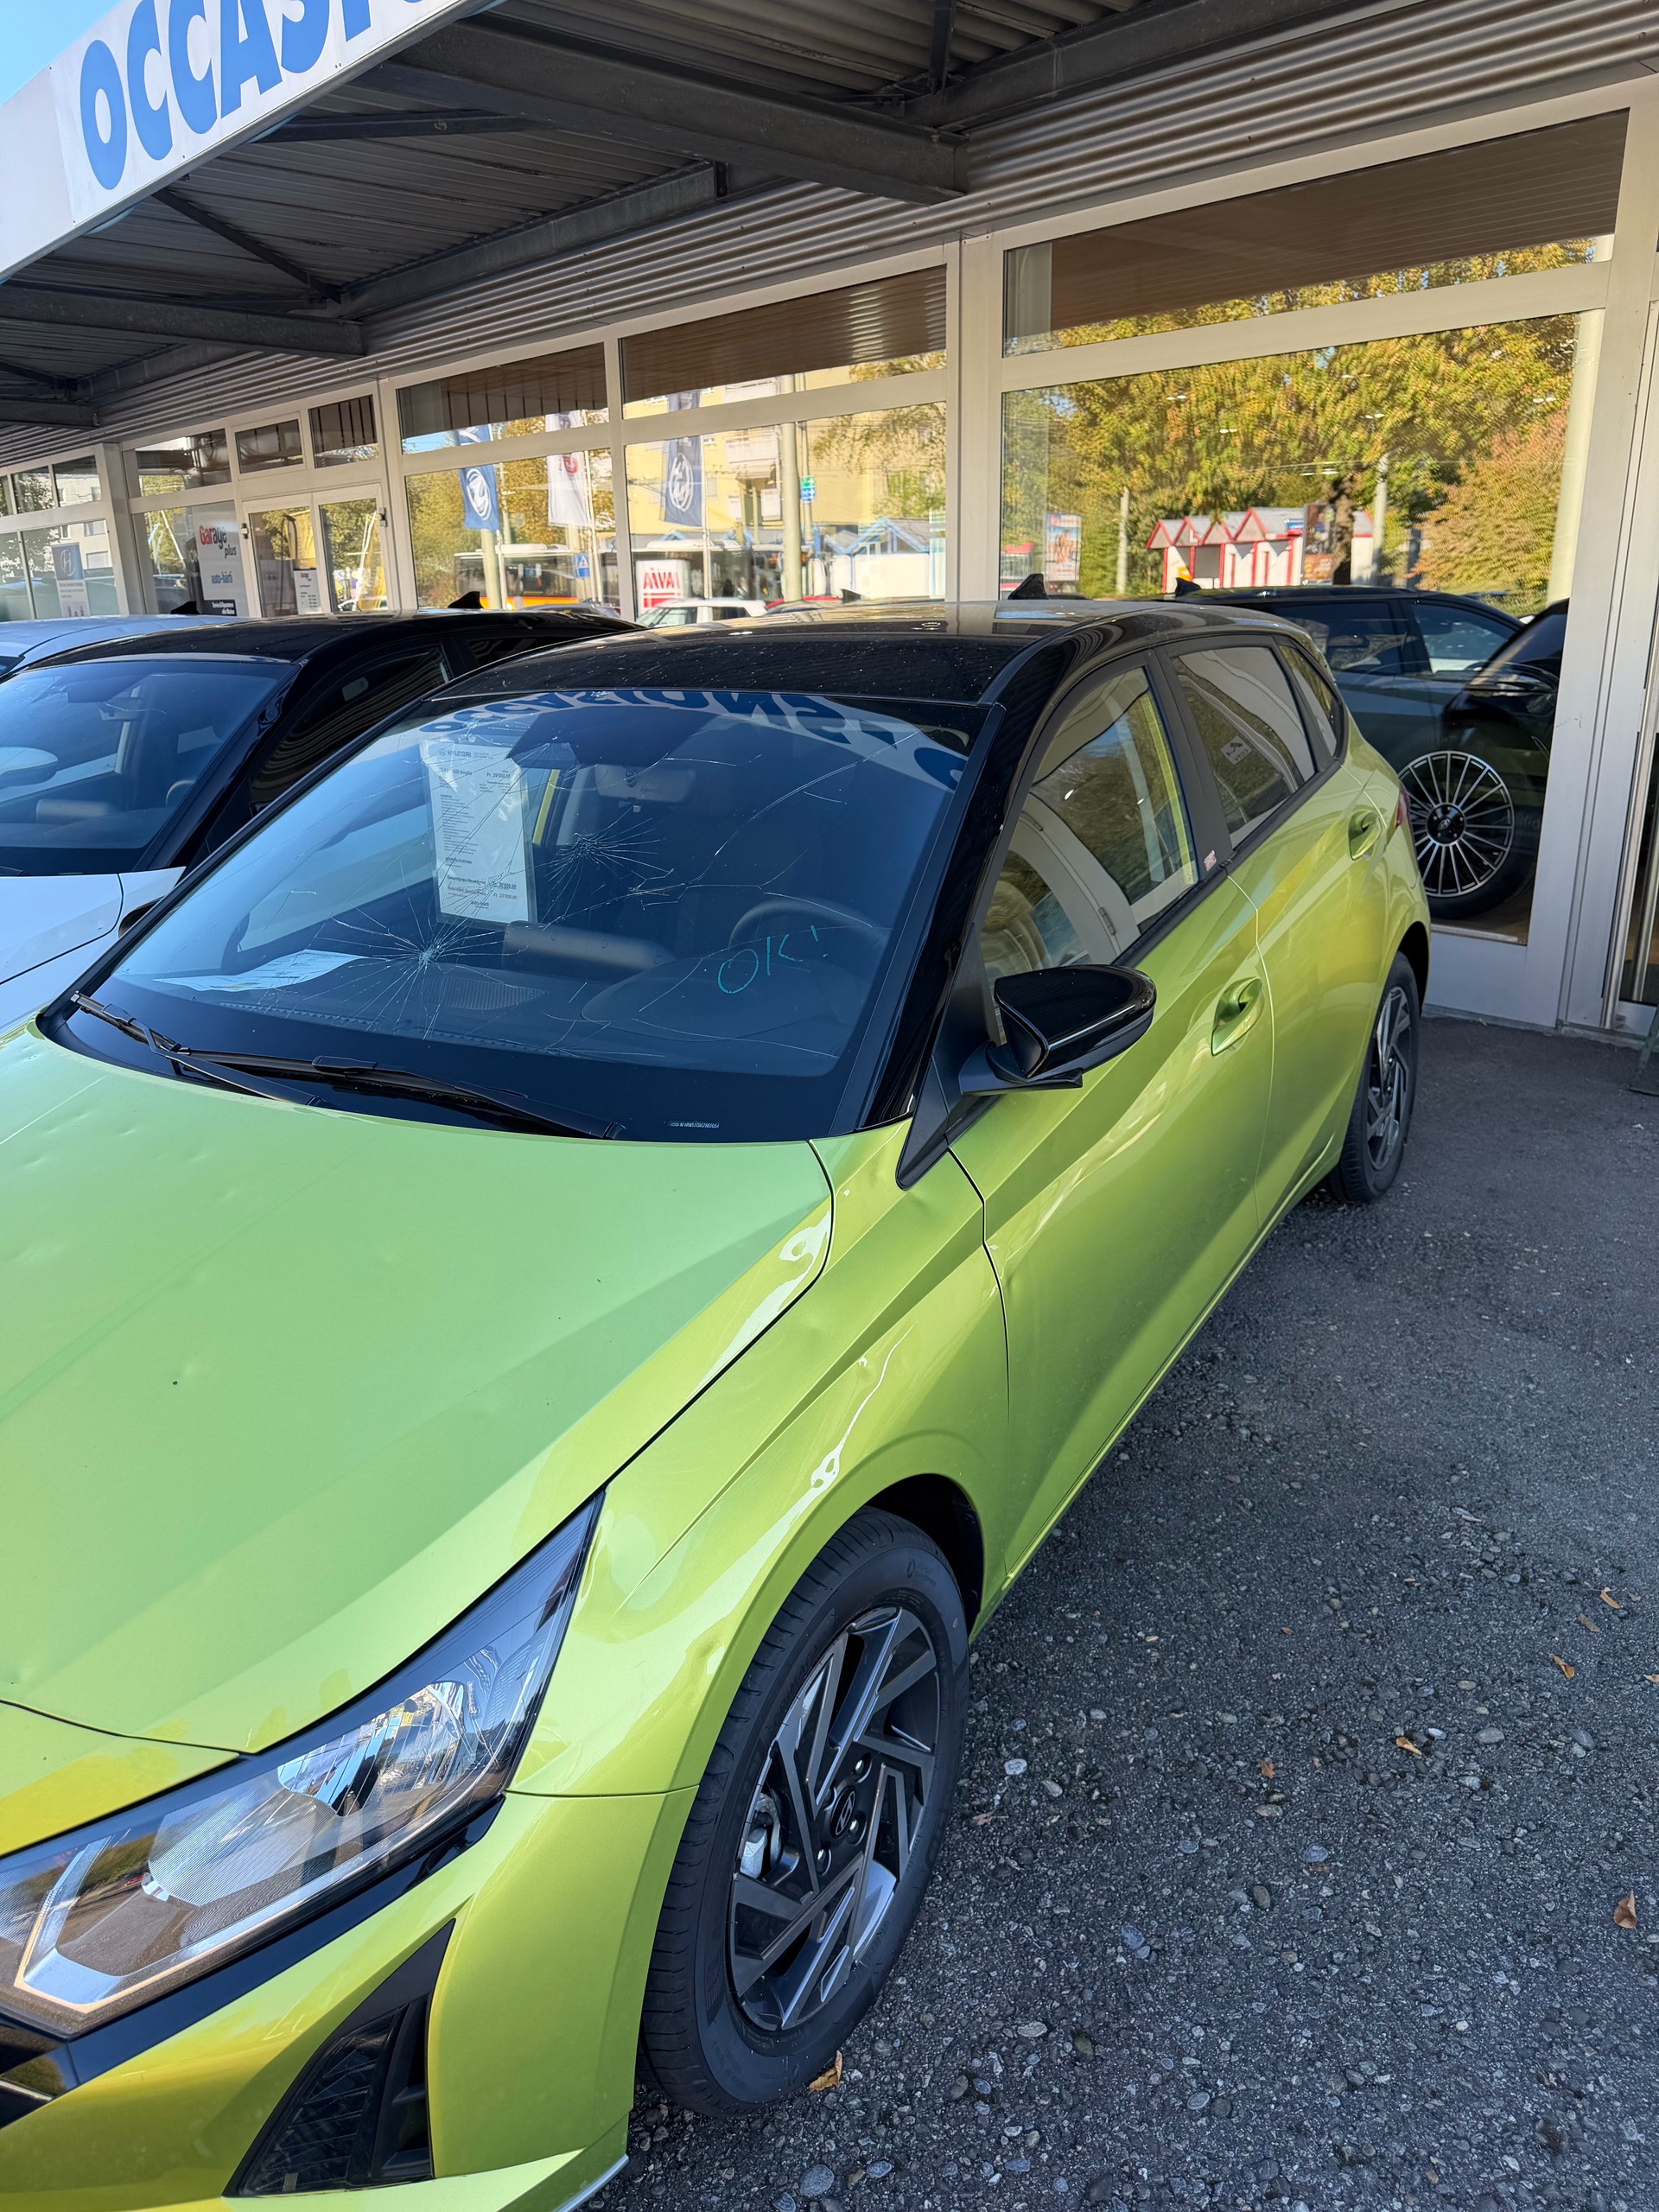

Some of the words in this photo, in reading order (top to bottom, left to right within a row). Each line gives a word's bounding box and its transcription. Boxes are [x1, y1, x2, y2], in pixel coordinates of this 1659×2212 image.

[79, 0, 421, 191] OCCA
[200, 524, 227, 550] Garage
[225, 544, 237, 559] plus
[448, 749, 472, 758] HYUNDAI
